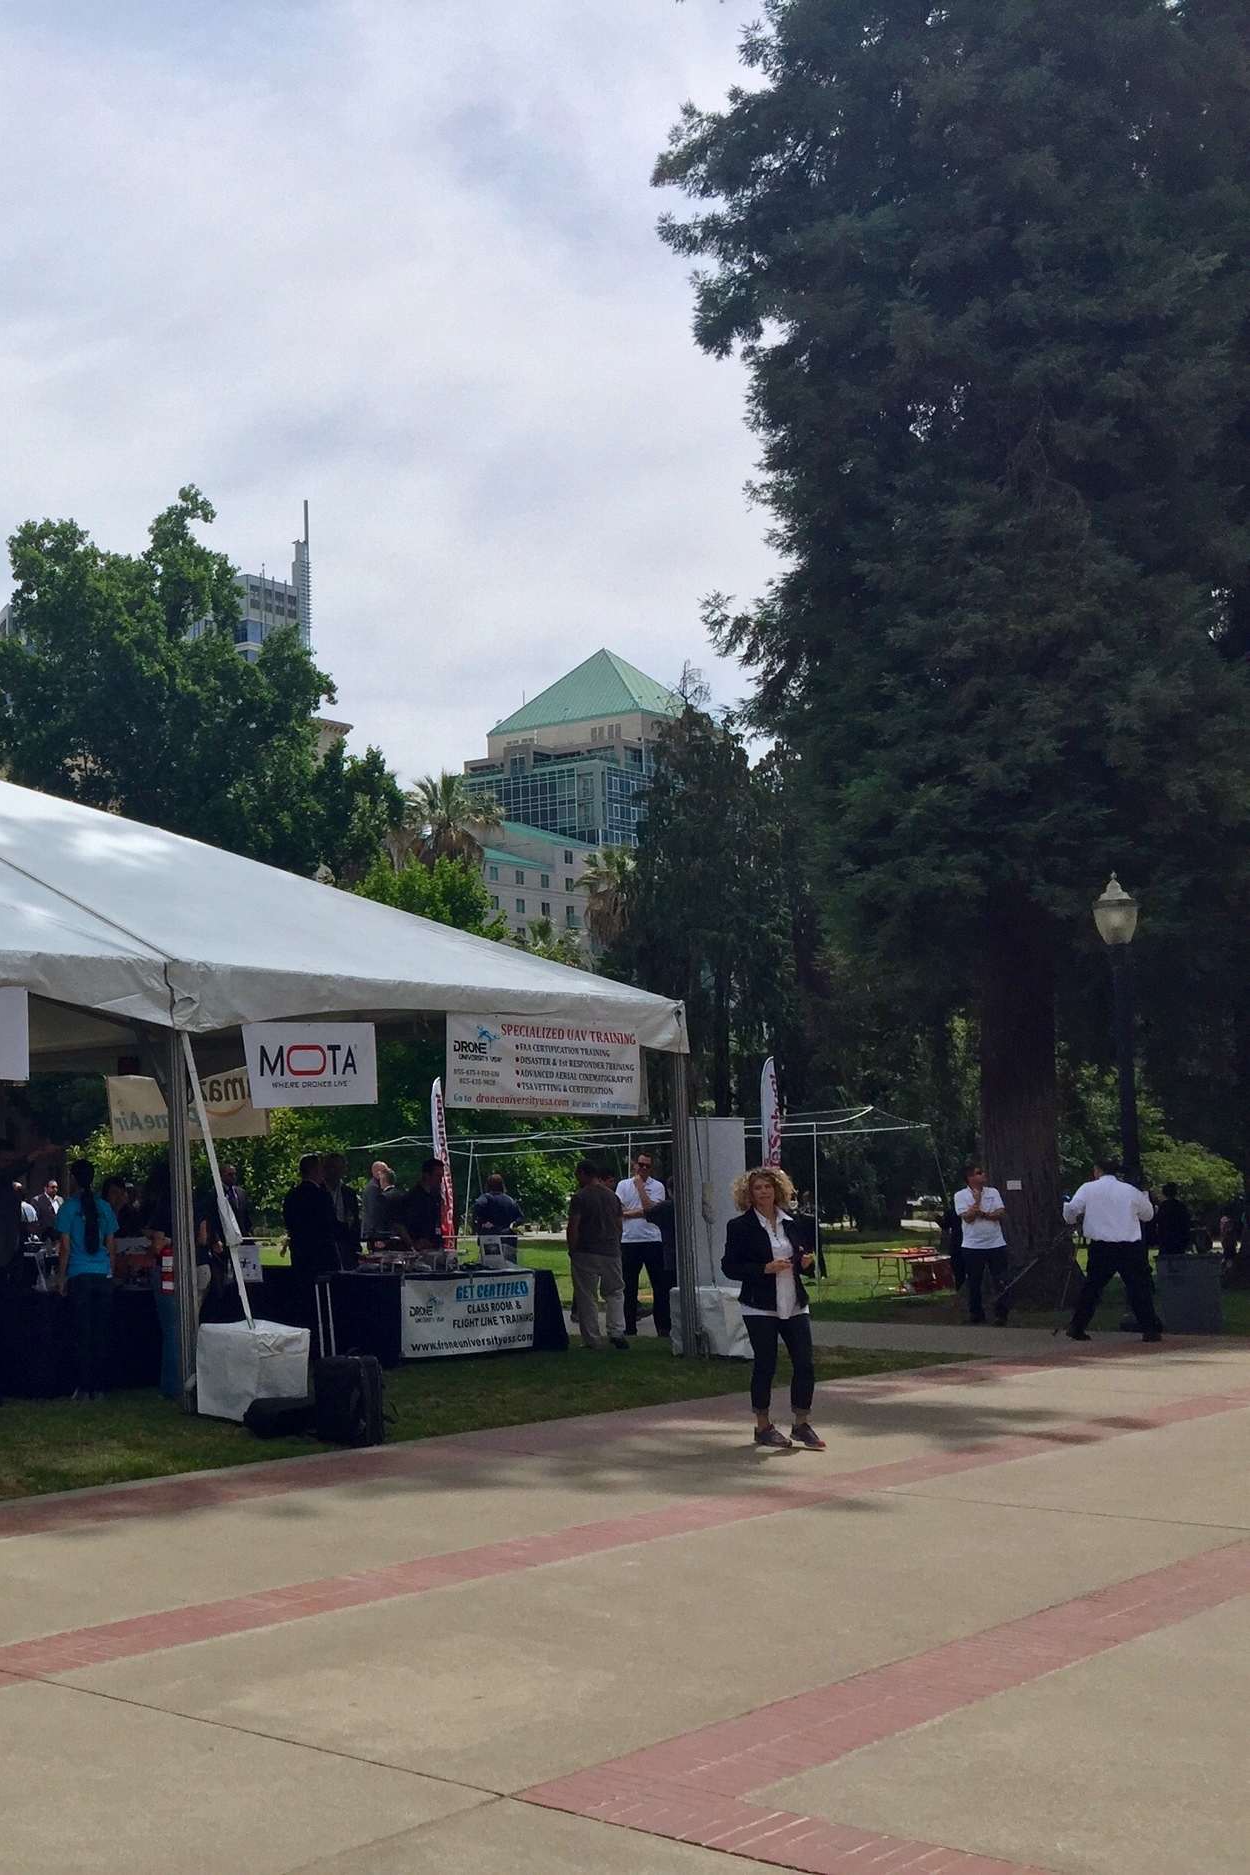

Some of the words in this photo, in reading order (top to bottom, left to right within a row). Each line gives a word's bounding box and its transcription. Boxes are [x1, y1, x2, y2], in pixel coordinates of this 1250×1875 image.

[500, 1023, 565, 1040] SPECIALIZED
[567, 1029, 587, 1042] UAV
[589, 1030, 637, 1045] TRAINING
[453, 1040, 487, 1054] DRONE
[533, 1044, 579, 1056] CERTIFICATION
[580, 1047, 610, 1058] TRAINING
[260, 1045, 357, 1076] MOTA
[520, 1056, 551, 1067] DISASTER
[569, 1059, 605, 1070] RESPONDER
[521, 1069, 554, 1079] ADVANCED
[555, 1071, 578, 1081] AERIAL
[302, 1080, 332, 1088] DRONES
[521, 1082, 534, 1091] TSA
[476, 1093, 569, 1108] droneuniversityusa.com
[456, 1285, 474, 1299] GET
[477, 1281, 528, 1298] CERTIFIED
[467, 1303, 490, 1314] CLASS
[491, 1300, 513, 1311] ROOM
[515, 1300, 522, 1309] &
[452, 1316, 479, 1329] FLIGHT
[480, 1315, 499, 1327] LINE
[501, 1313, 534, 1325] TRAINING
